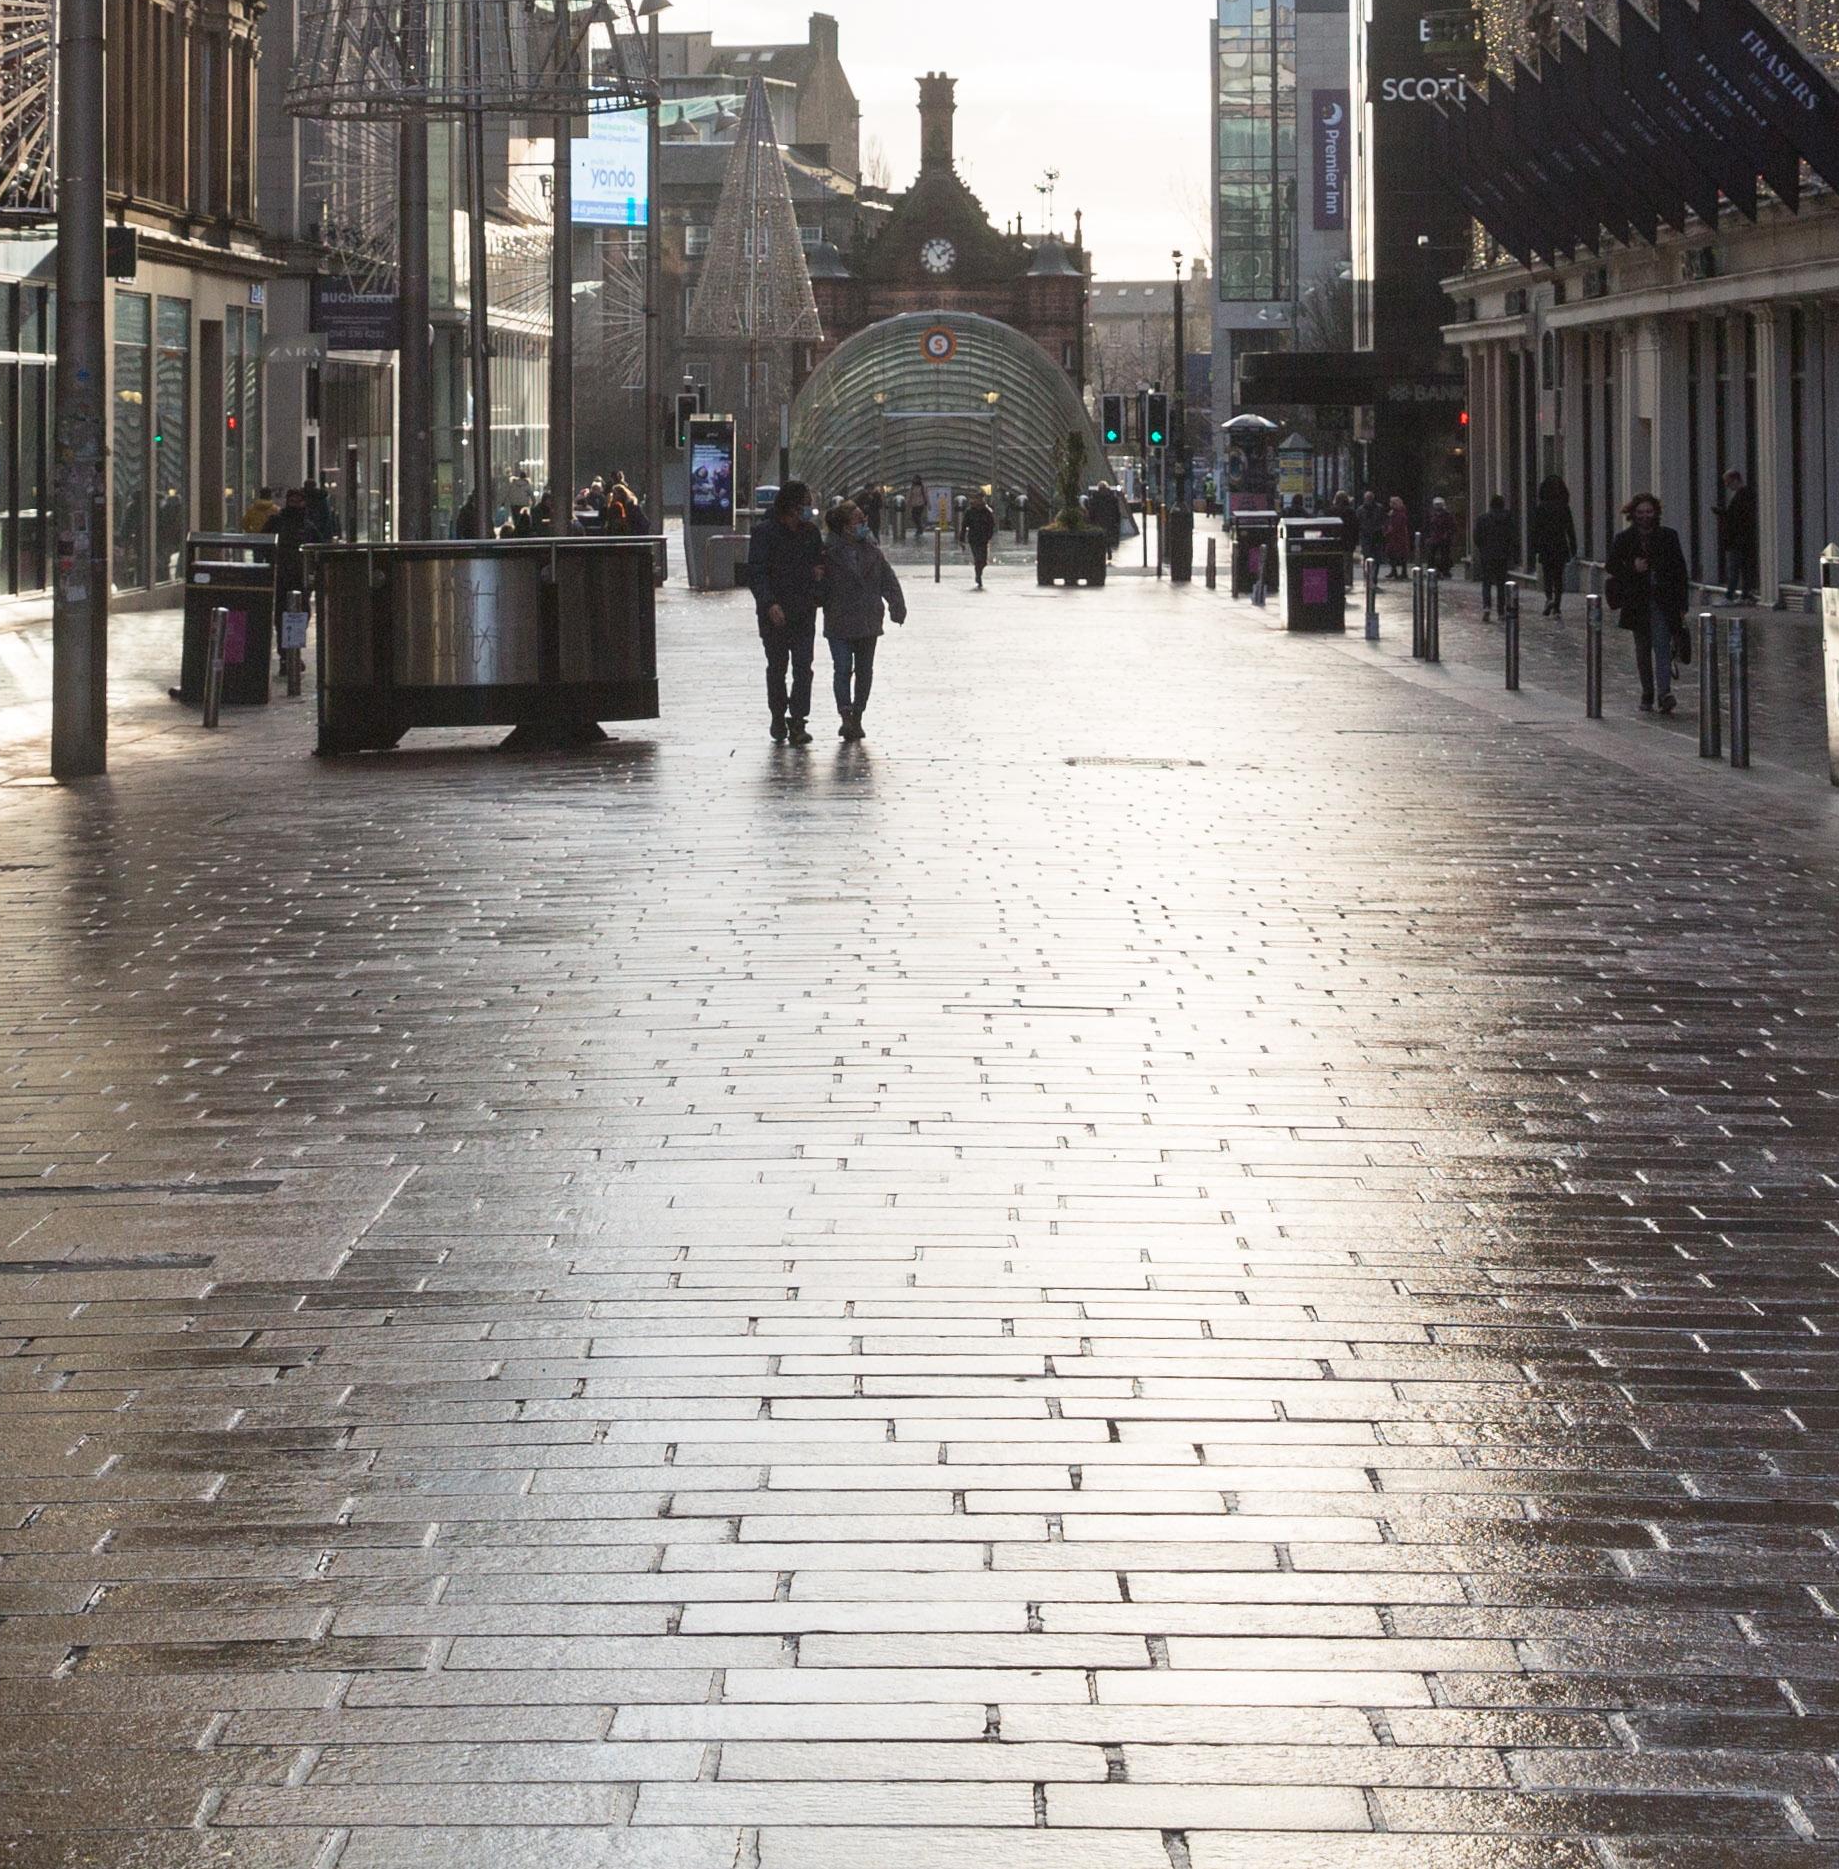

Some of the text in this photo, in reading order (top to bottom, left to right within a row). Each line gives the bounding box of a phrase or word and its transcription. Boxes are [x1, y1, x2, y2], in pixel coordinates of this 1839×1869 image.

[1741, 29, 1820, 110] FRASERS
[1382, 77, 1466, 101] SCOTL
[591, 166, 636, 189] yondo
[1325, 129, 1340, 214] Premier Inn
[268, 347, 321, 357] ZARA
[934, 338, 943, 351] S
